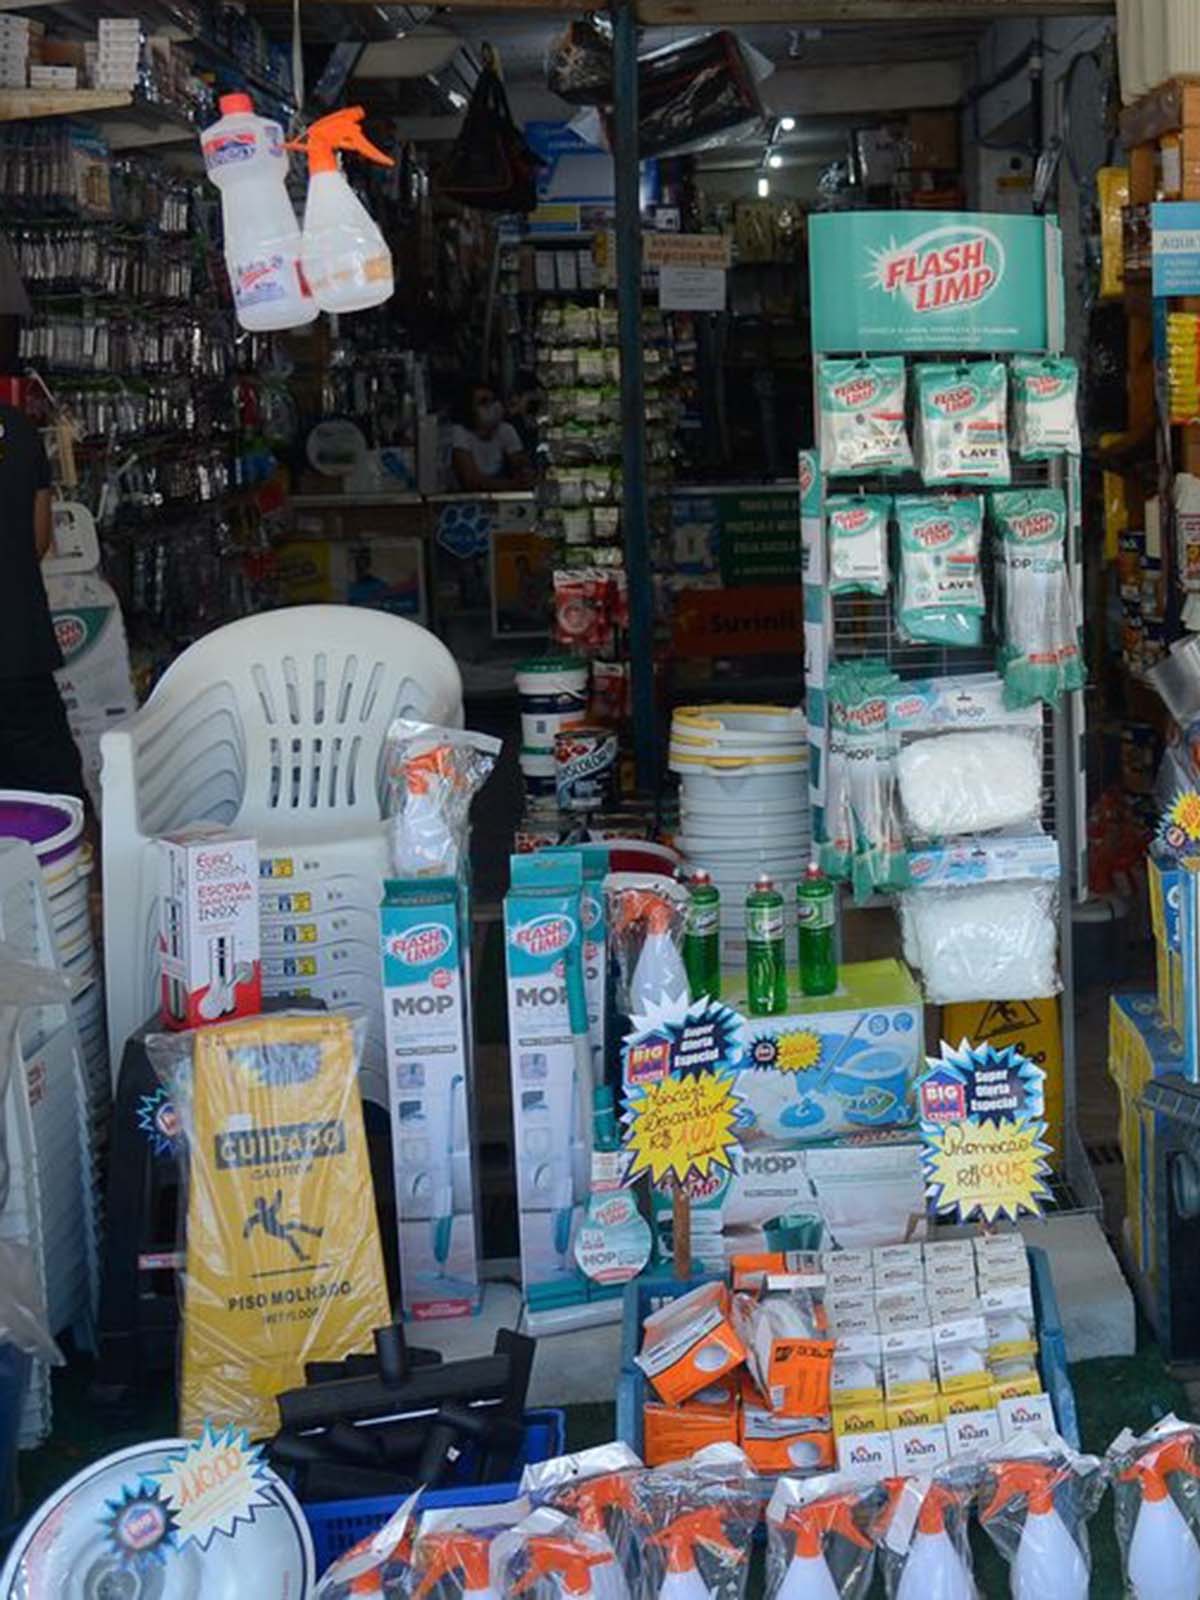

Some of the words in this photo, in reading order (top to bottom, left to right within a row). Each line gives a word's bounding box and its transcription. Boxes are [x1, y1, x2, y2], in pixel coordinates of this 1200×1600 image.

[885, 240, 984, 289] FLASH
[916, 268, 992, 310] LIMP
[959, 447, 999, 459] LAVE
[198, 904, 240, 923] INOX
[392, 927, 441, 953] FLASH
[406, 940, 447, 963] LIMP
[392, 994, 454, 1017] MOP
[633, 1045, 664, 1065] BIG
[974, 1070, 1008, 1084] Super
[925, 1085, 959, 1101] BIG
[974, 1084, 1011, 1098] Oferta
[970, 1096, 1018, 1112] Especial
[219, 1127, 340, 1161] CUIDADO
[742, 1156, 798, 1175] MOP
[227, 1293, 268, 1312] PISO
[271, 1281, 351, 1305] MOLHADO
[897, 1408, 930, 1427] kian
[1010, 1407, 1042, 1425] kian
[957, 1424, 990, 1441] kian
[850, 1447, 882, 1464] kian
[903, 1438, 937, 1456] kian
